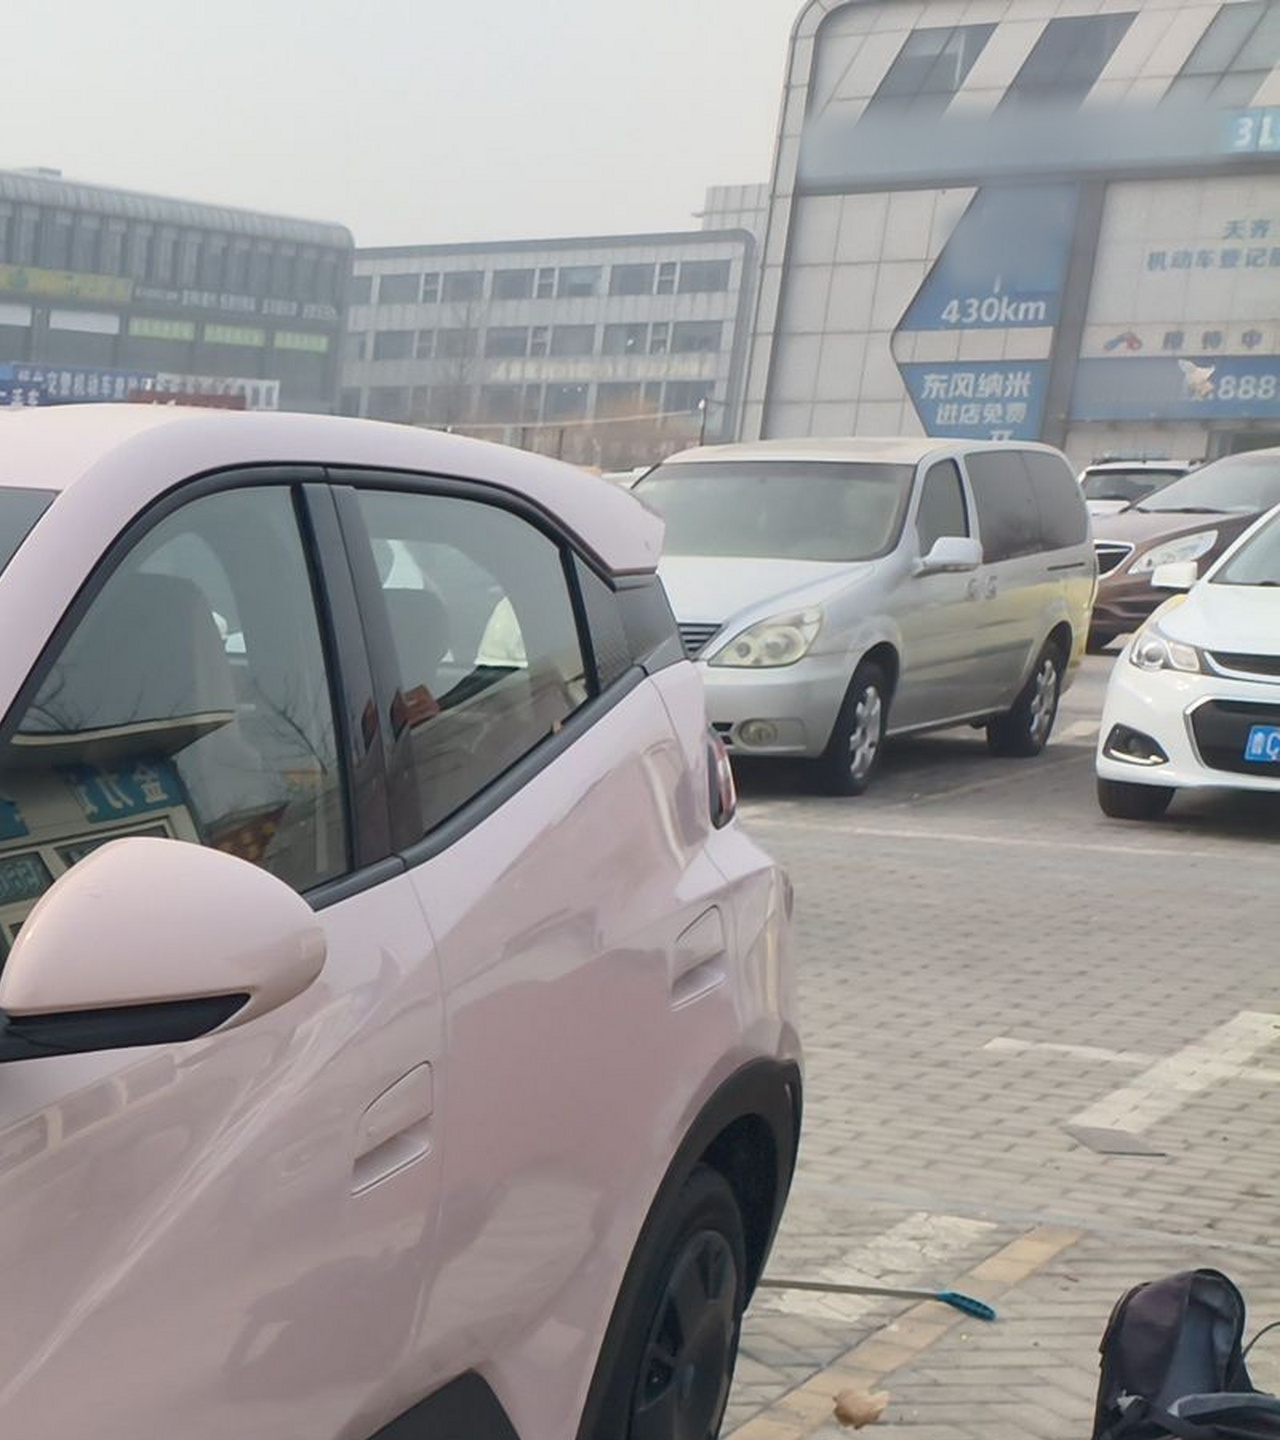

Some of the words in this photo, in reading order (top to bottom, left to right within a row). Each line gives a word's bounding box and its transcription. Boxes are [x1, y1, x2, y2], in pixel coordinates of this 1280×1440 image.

[941, 297, 1047, 323] 430km
[921, 371, 1031, 399] 东风纳米
[935, 402, 1027, 425] 进店免费
